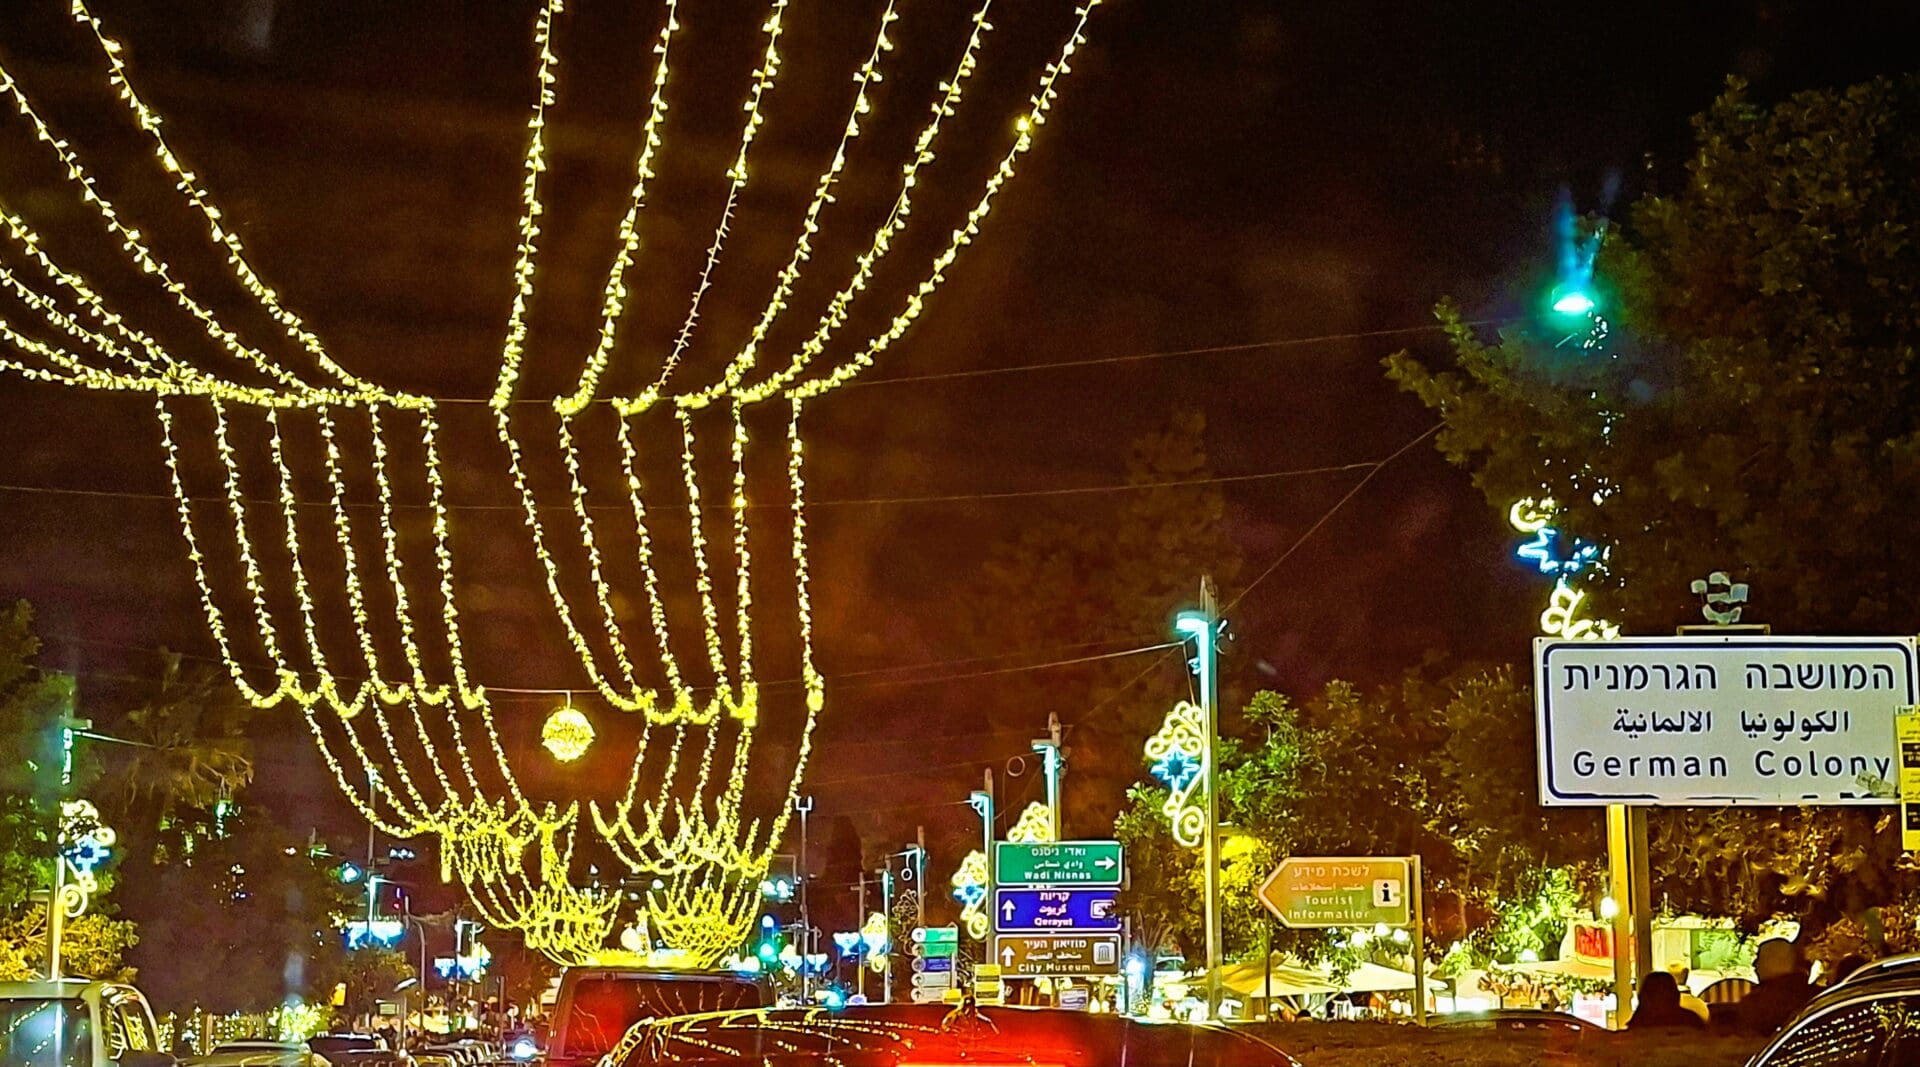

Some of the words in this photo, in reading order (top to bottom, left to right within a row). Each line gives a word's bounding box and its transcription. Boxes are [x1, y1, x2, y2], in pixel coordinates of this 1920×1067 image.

[1563, 664, 1718, 690] הגרמנית
[1745, 663, 1895, 690] המושבה
[1612, 708, 1712, 738] الالمانية
[1740, 709, 1850, 741] الكولونيا
[1573, 751, 1728, 777] German
[1754, 750, 1892, 780] Colony
[1064, 847, 1086, 857] ואדי
[1024, 871, 1050, 880] Wadi
[1053, 871, 1091, 880] Nisnas
[1294, 866, 1326, 877] מידע
[1332, 865, 1370, 876] לשכת
[1040, 892, 1070, 902] קריות
[1305, 895, 1353, 905] Tourist
[1024, 939, 1048, 949] העיר
[1053, 939, 1087, 950] מוזיאון
[1018, 963, 1042, 973] City
[1046, 962, 1091, 972] Museum
